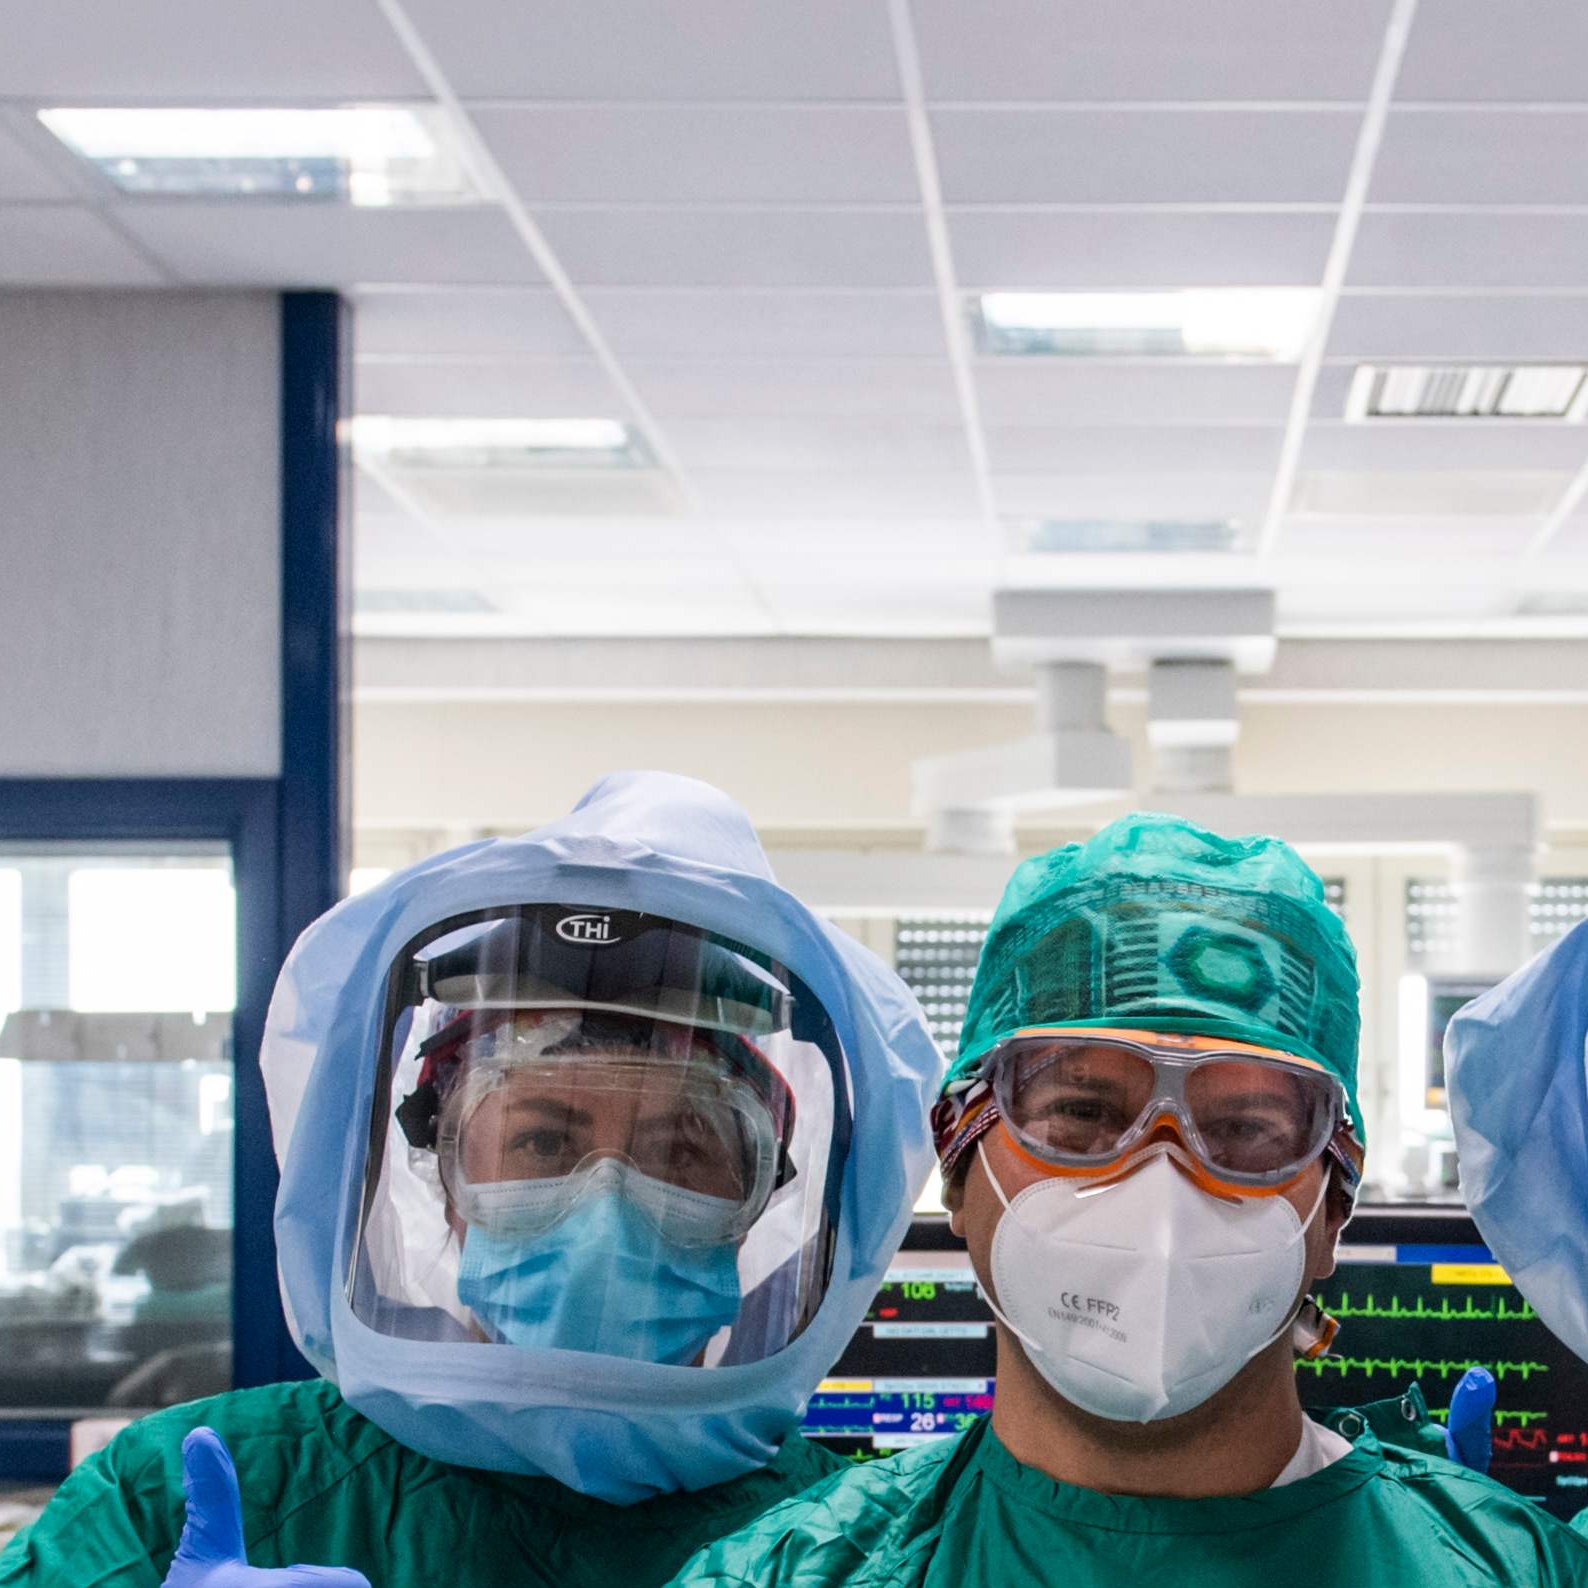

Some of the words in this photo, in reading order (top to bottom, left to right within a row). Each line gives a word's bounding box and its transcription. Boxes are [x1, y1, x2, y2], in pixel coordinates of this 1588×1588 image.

[1060, 1291, 1081, 1311] CE
[1086, 1297, 1120, 1321] FFP2
[910, 1412, 936, 1432] 26
